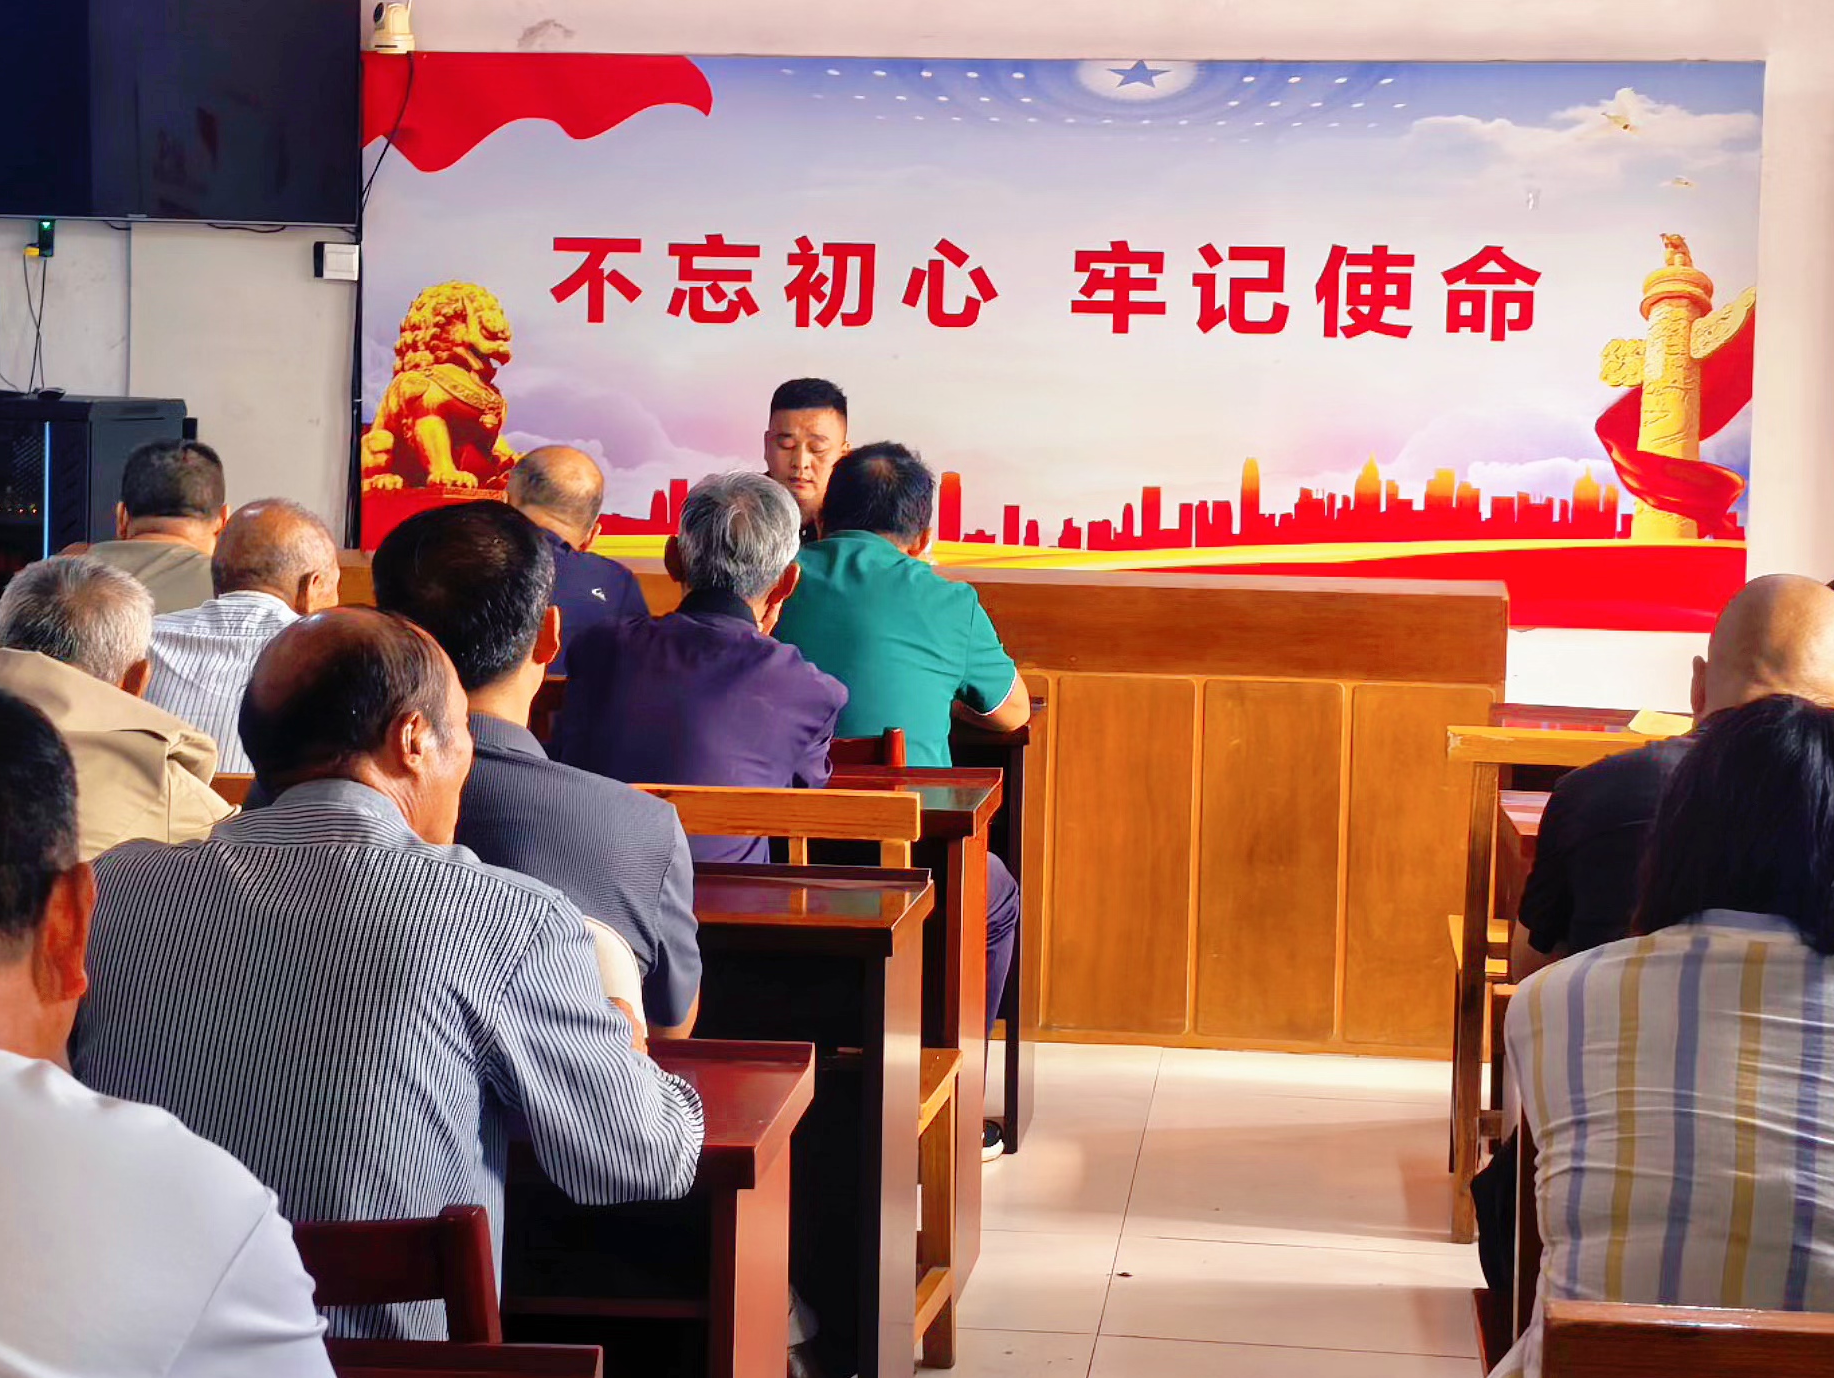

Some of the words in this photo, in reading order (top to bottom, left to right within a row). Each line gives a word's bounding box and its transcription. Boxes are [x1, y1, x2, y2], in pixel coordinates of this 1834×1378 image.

[551, 235, 999, 329] 不忘初心
[1071, 241, 1543, 342] 牢记使命
